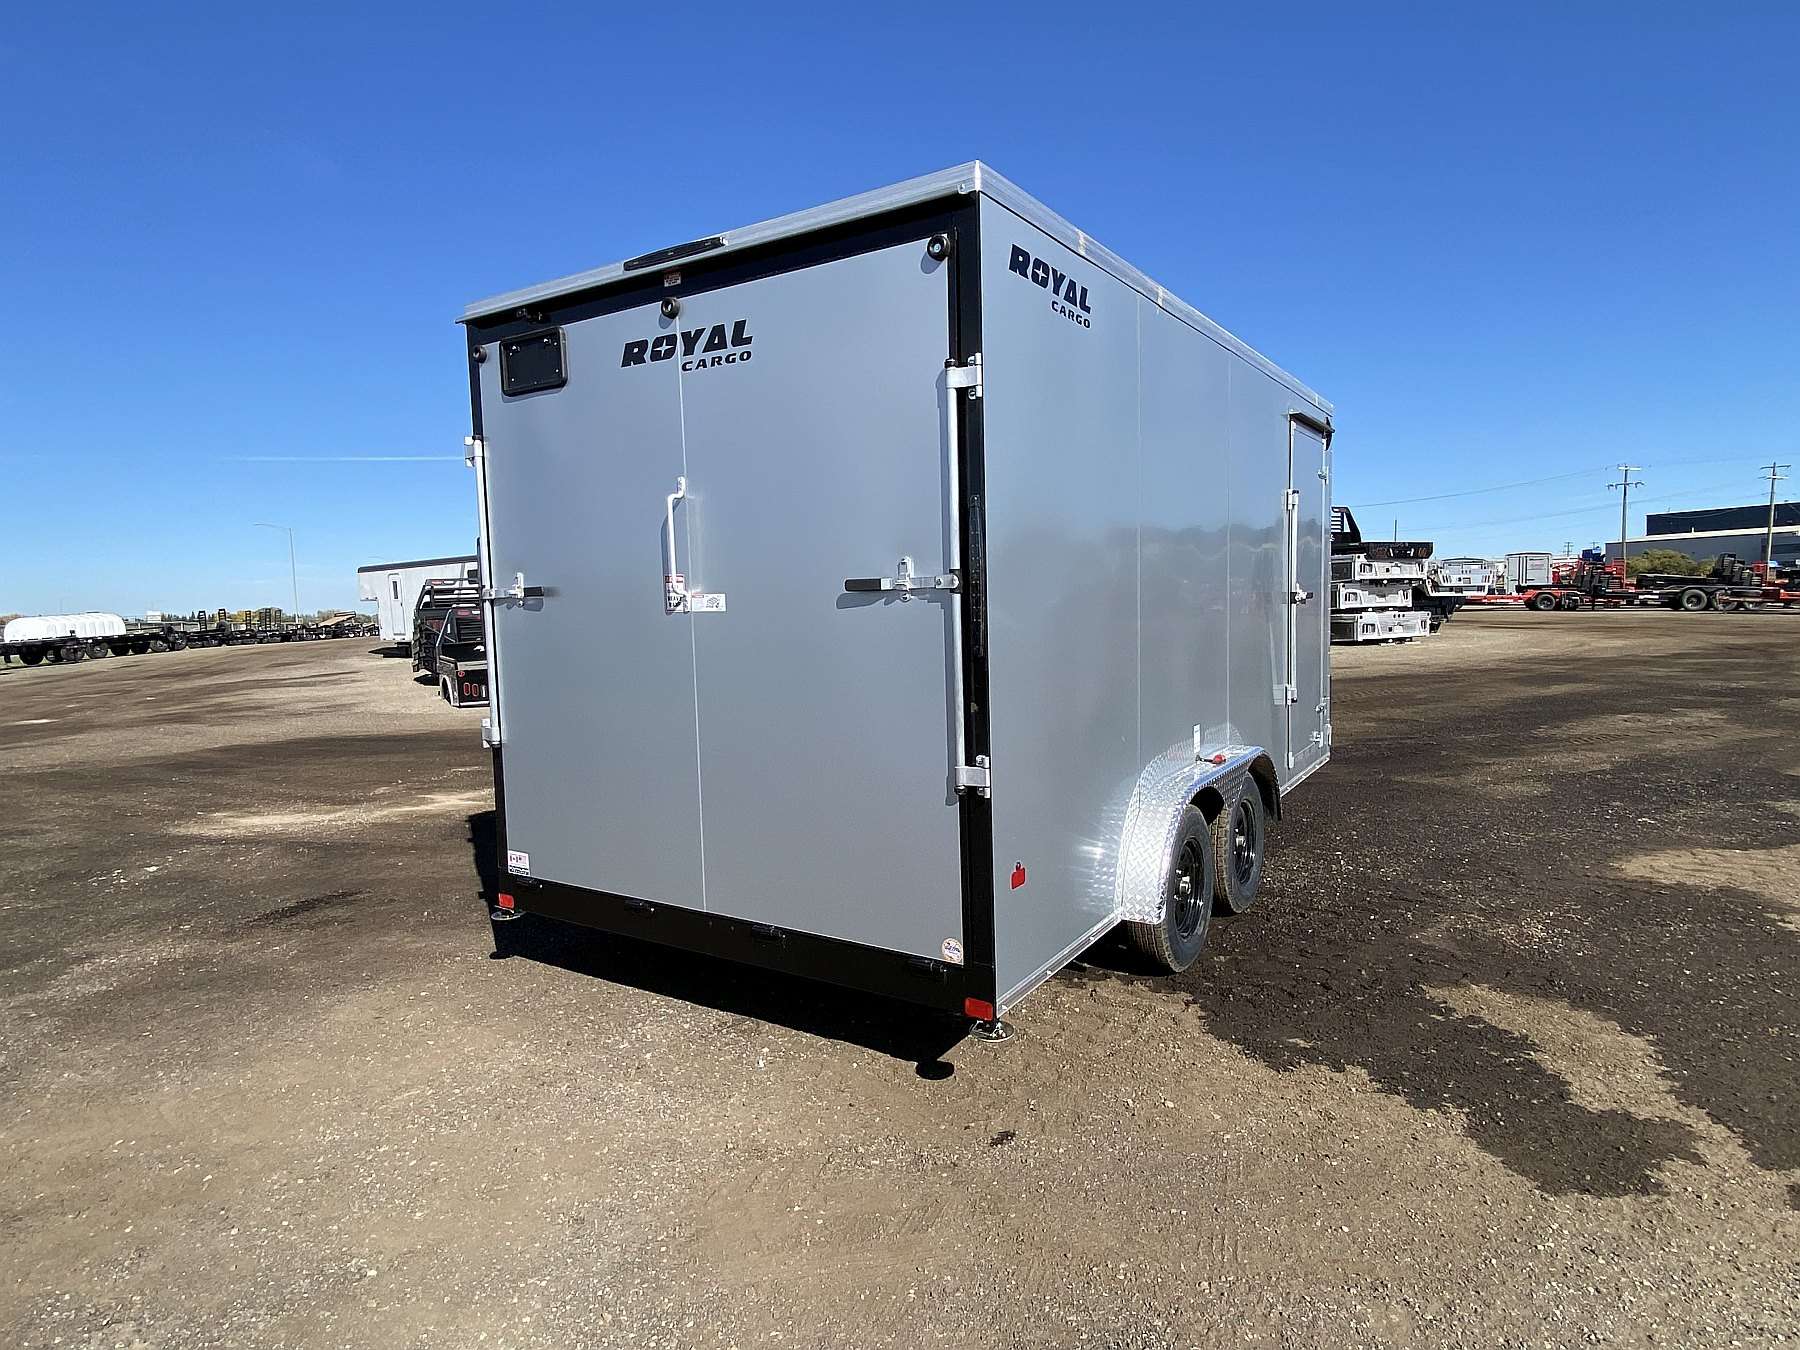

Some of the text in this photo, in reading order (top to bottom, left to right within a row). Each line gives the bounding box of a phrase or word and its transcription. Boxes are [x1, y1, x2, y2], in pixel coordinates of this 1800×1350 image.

[1008, 243, 1091, 315] ROYAL
[1051, 300, 1091, 329] CARGO
[621, 319, 753, 368] ROYAL
[681, 350, 752, 372] CARGO
